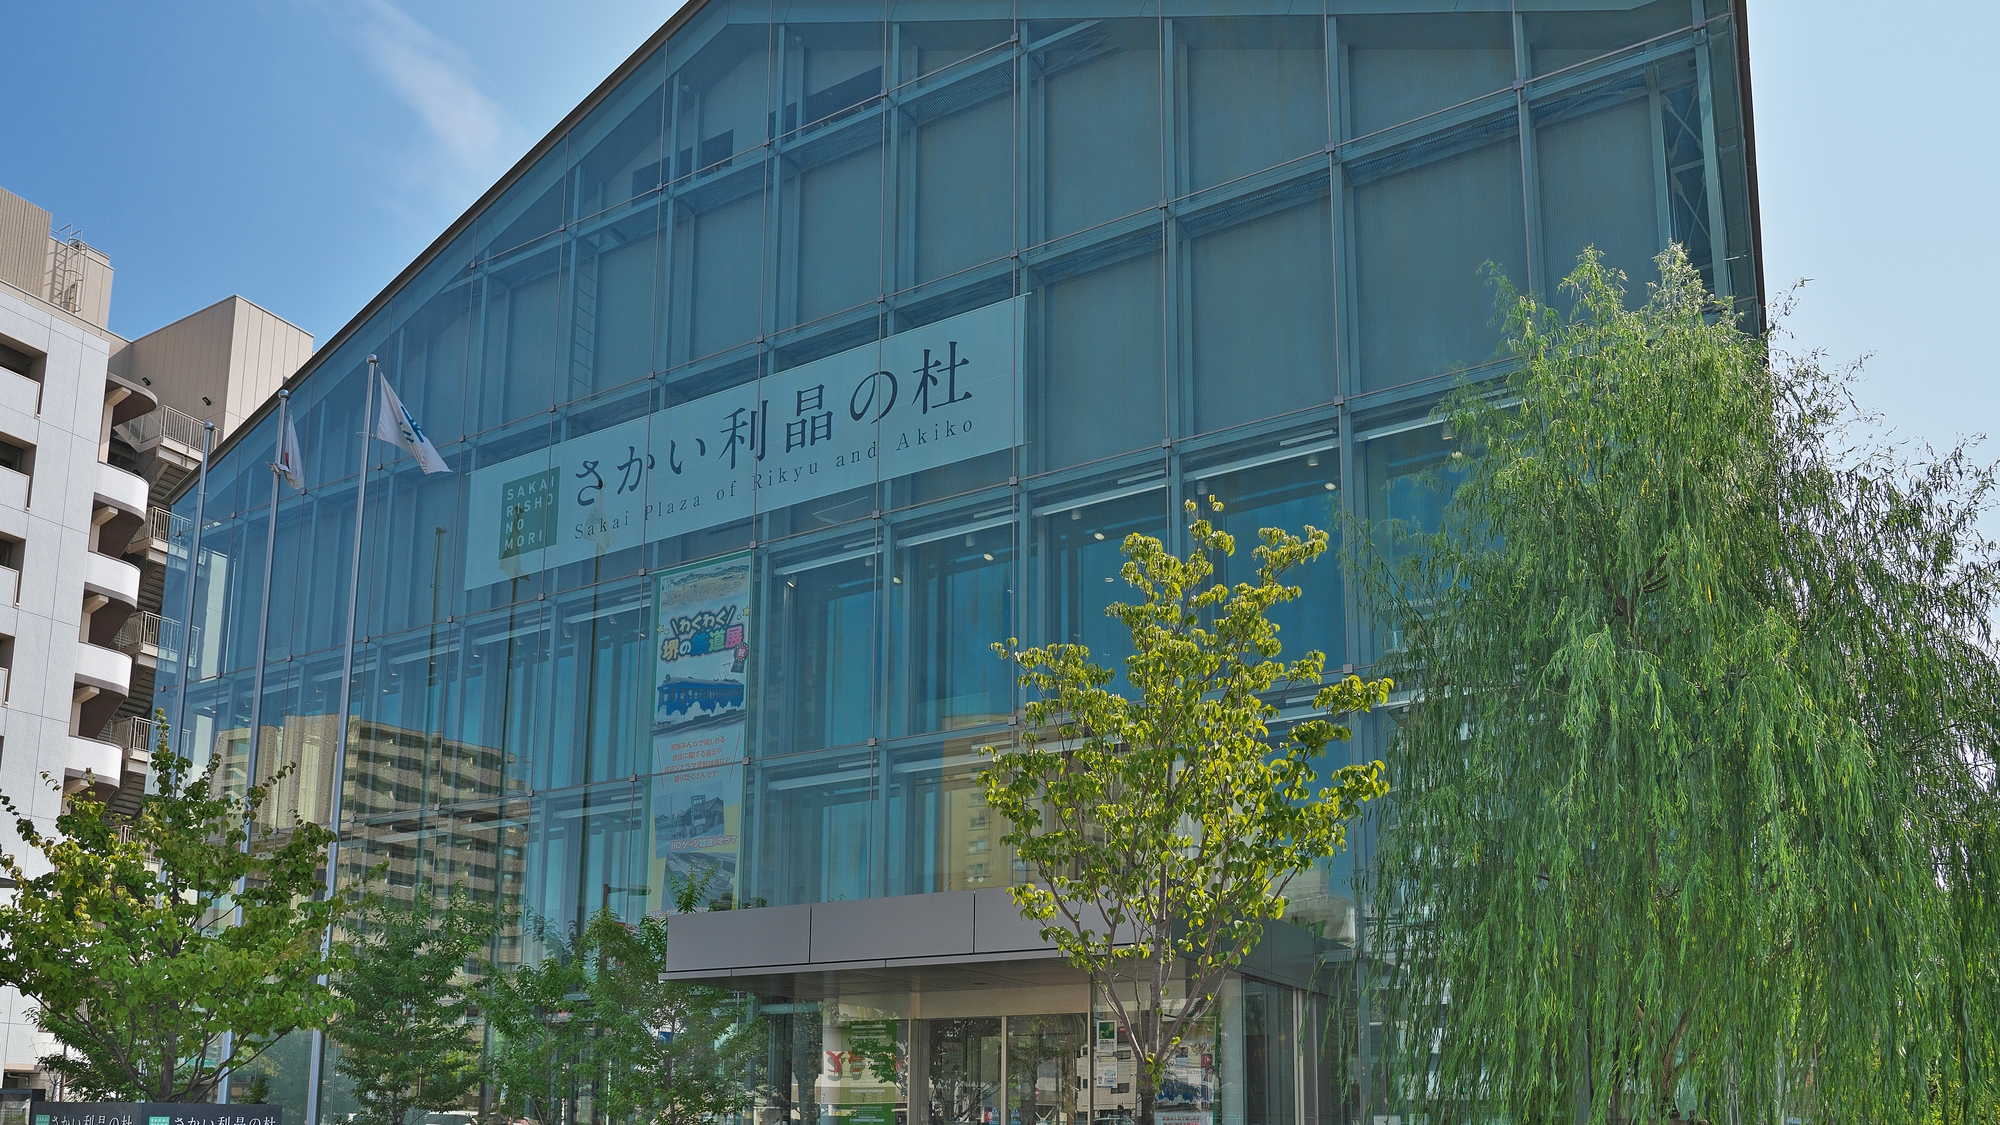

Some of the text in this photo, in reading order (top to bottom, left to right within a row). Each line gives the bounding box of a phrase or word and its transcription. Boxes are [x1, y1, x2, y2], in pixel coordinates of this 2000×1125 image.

[575, 341, 973, 506] さかい利晶の杜
[507, 476, 555, 501] SAKAI
[574, 419, 973, 539] Sakai Plaza of Rikyu and Akiko
[506, 493, 554, 518] RISHO
[505, 518, 524, 534] NO
[504, 529, 543, 551] MORI
[678, 609, 727, 633] わくわく
[662, 625, 743, 661] 堺の鉄道展
[174, 1116, 276, 1125] さかい利晶の杜
